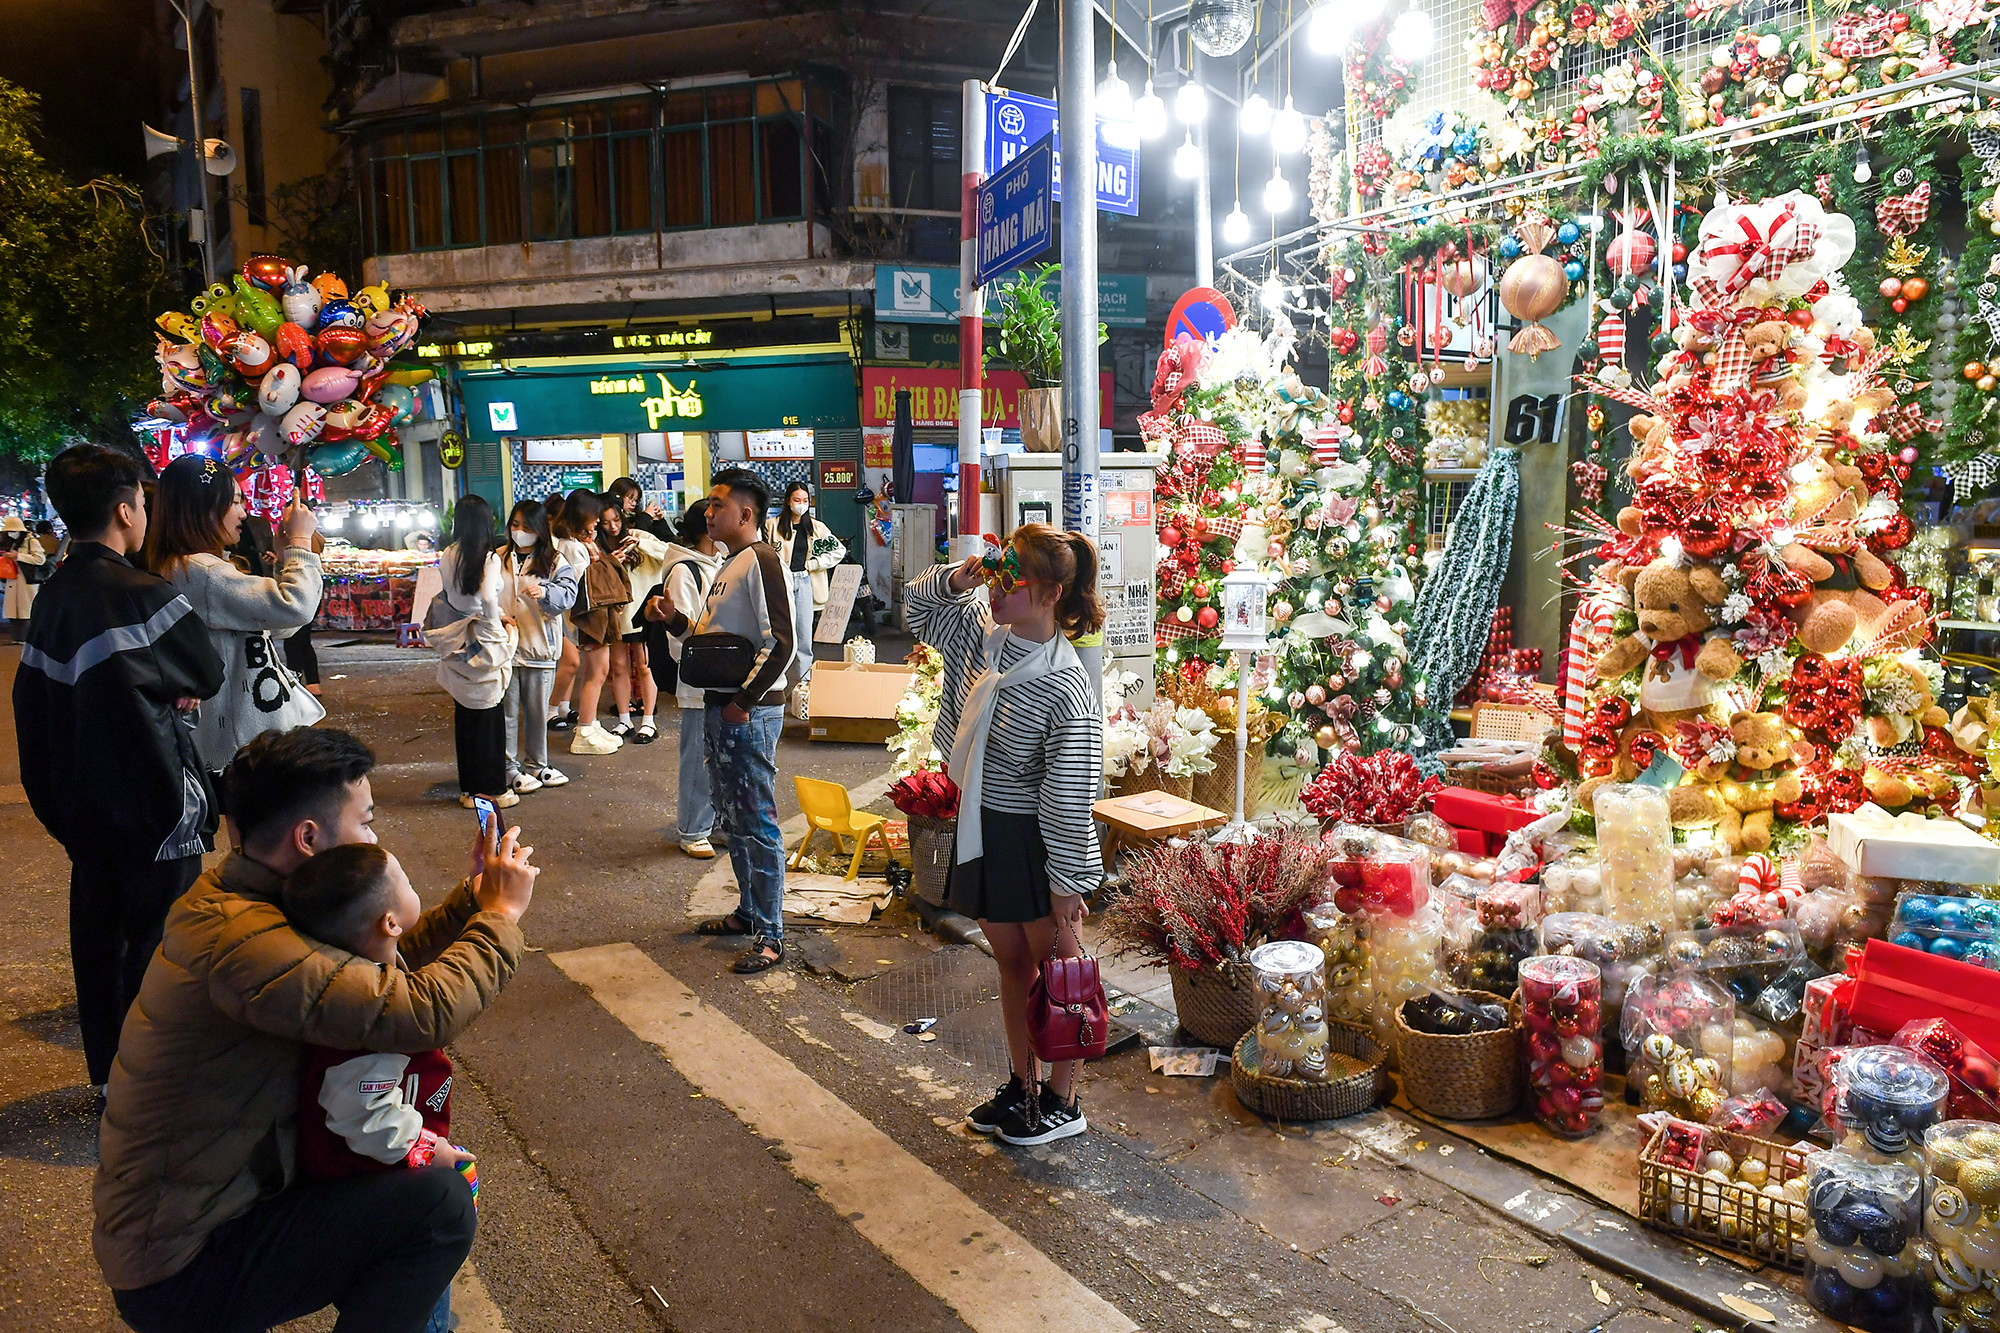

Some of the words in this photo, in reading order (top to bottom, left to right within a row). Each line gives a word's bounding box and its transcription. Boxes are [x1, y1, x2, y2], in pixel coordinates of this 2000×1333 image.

[1005, 160, 1030, 200] PHỐ
[983, 216, 1019, 265] HÀNG
[1022, 188, 1045, 242] MÃ
[685, 329, 712, 344] CÂY
[590, 375, 627, 394] BÁNH
[640, 372, 703, 430] phố
[782, 415, 799, 425] 61E
[1504, 394, 1566, 445] 61
[328, 599, 360, 616] GIA
[1137, 633, 1149, 645] 432
